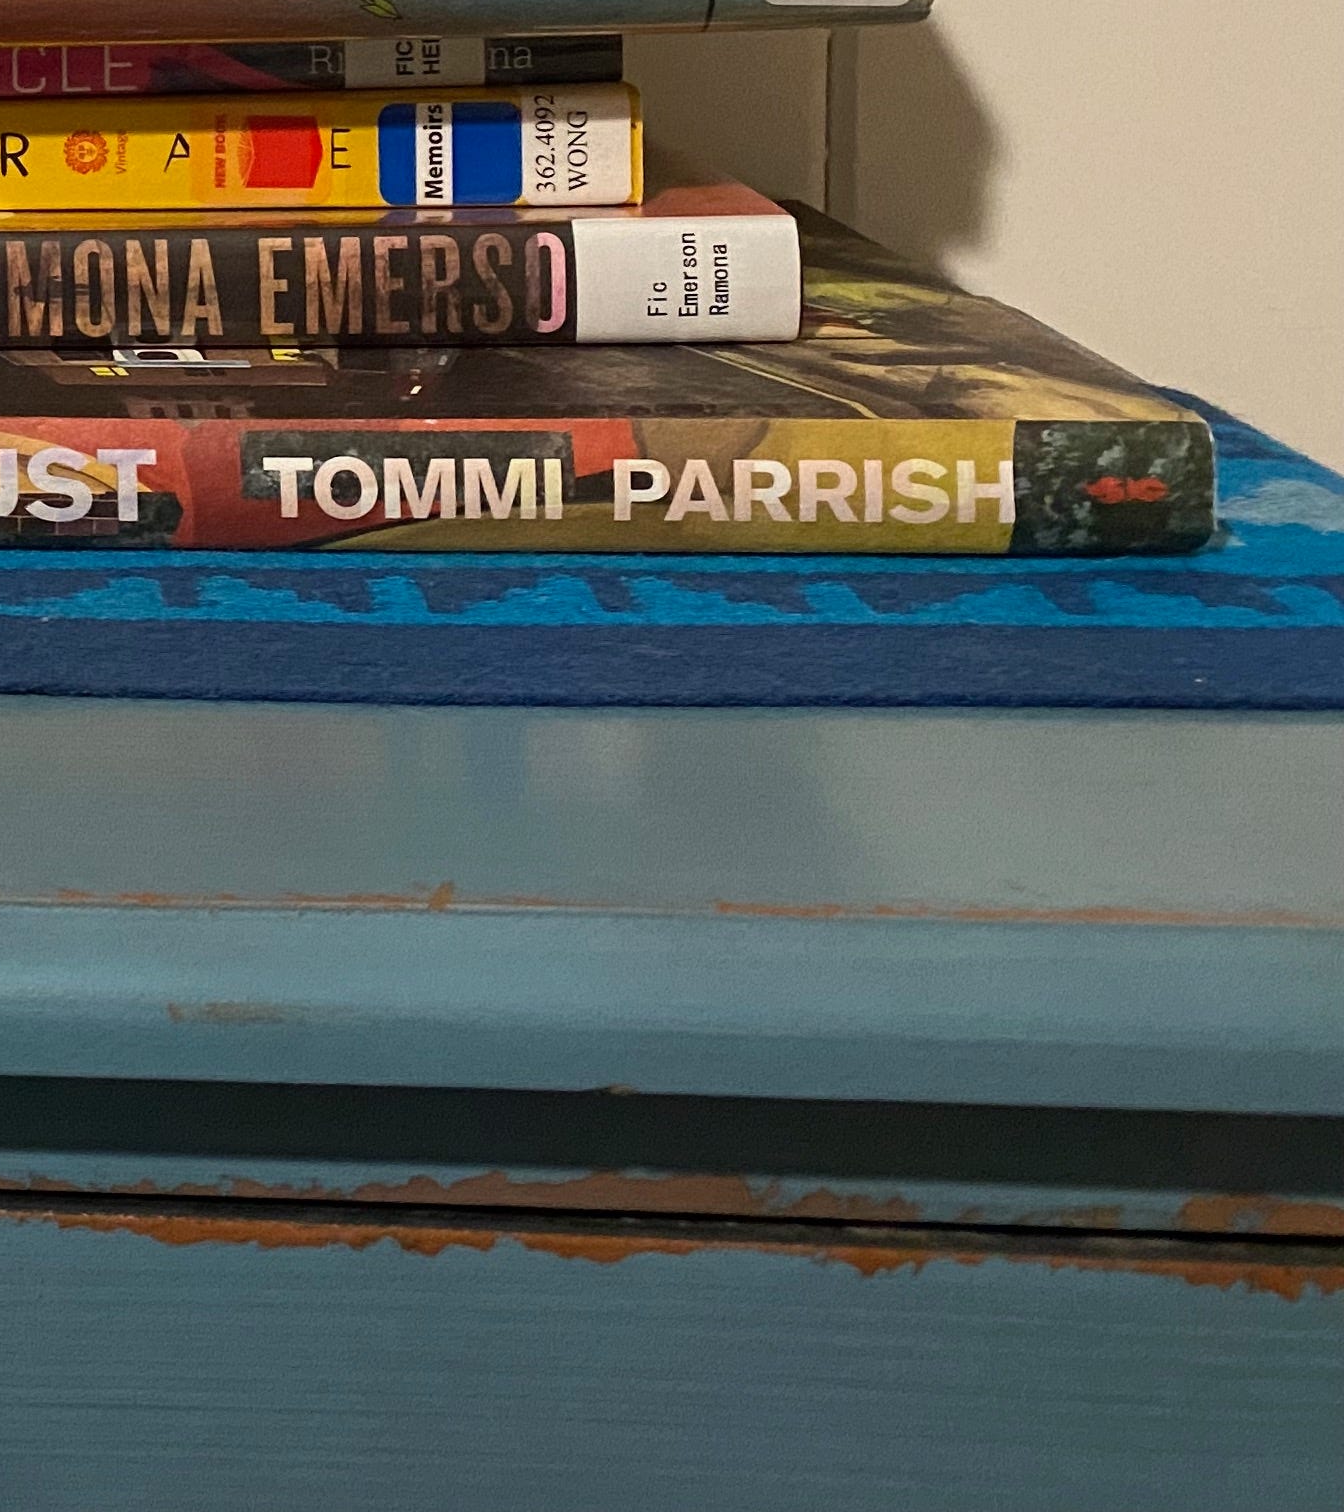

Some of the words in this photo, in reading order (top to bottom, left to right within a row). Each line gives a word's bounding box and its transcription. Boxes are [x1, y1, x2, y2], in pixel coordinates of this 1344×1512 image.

[423, 101, 444, 200] Memoirs
[536, 94, 558, 193] 362.4092
[568, 108, 590, 192] WONG
[647, 280, 667, 318] Fic
[679, 231, 698, 318] Emerson
[709, 243, 729, 316] Ramona
[261, 456, 564, 522] TOMMI
[612, 458, 1017, 525] PARRISH
